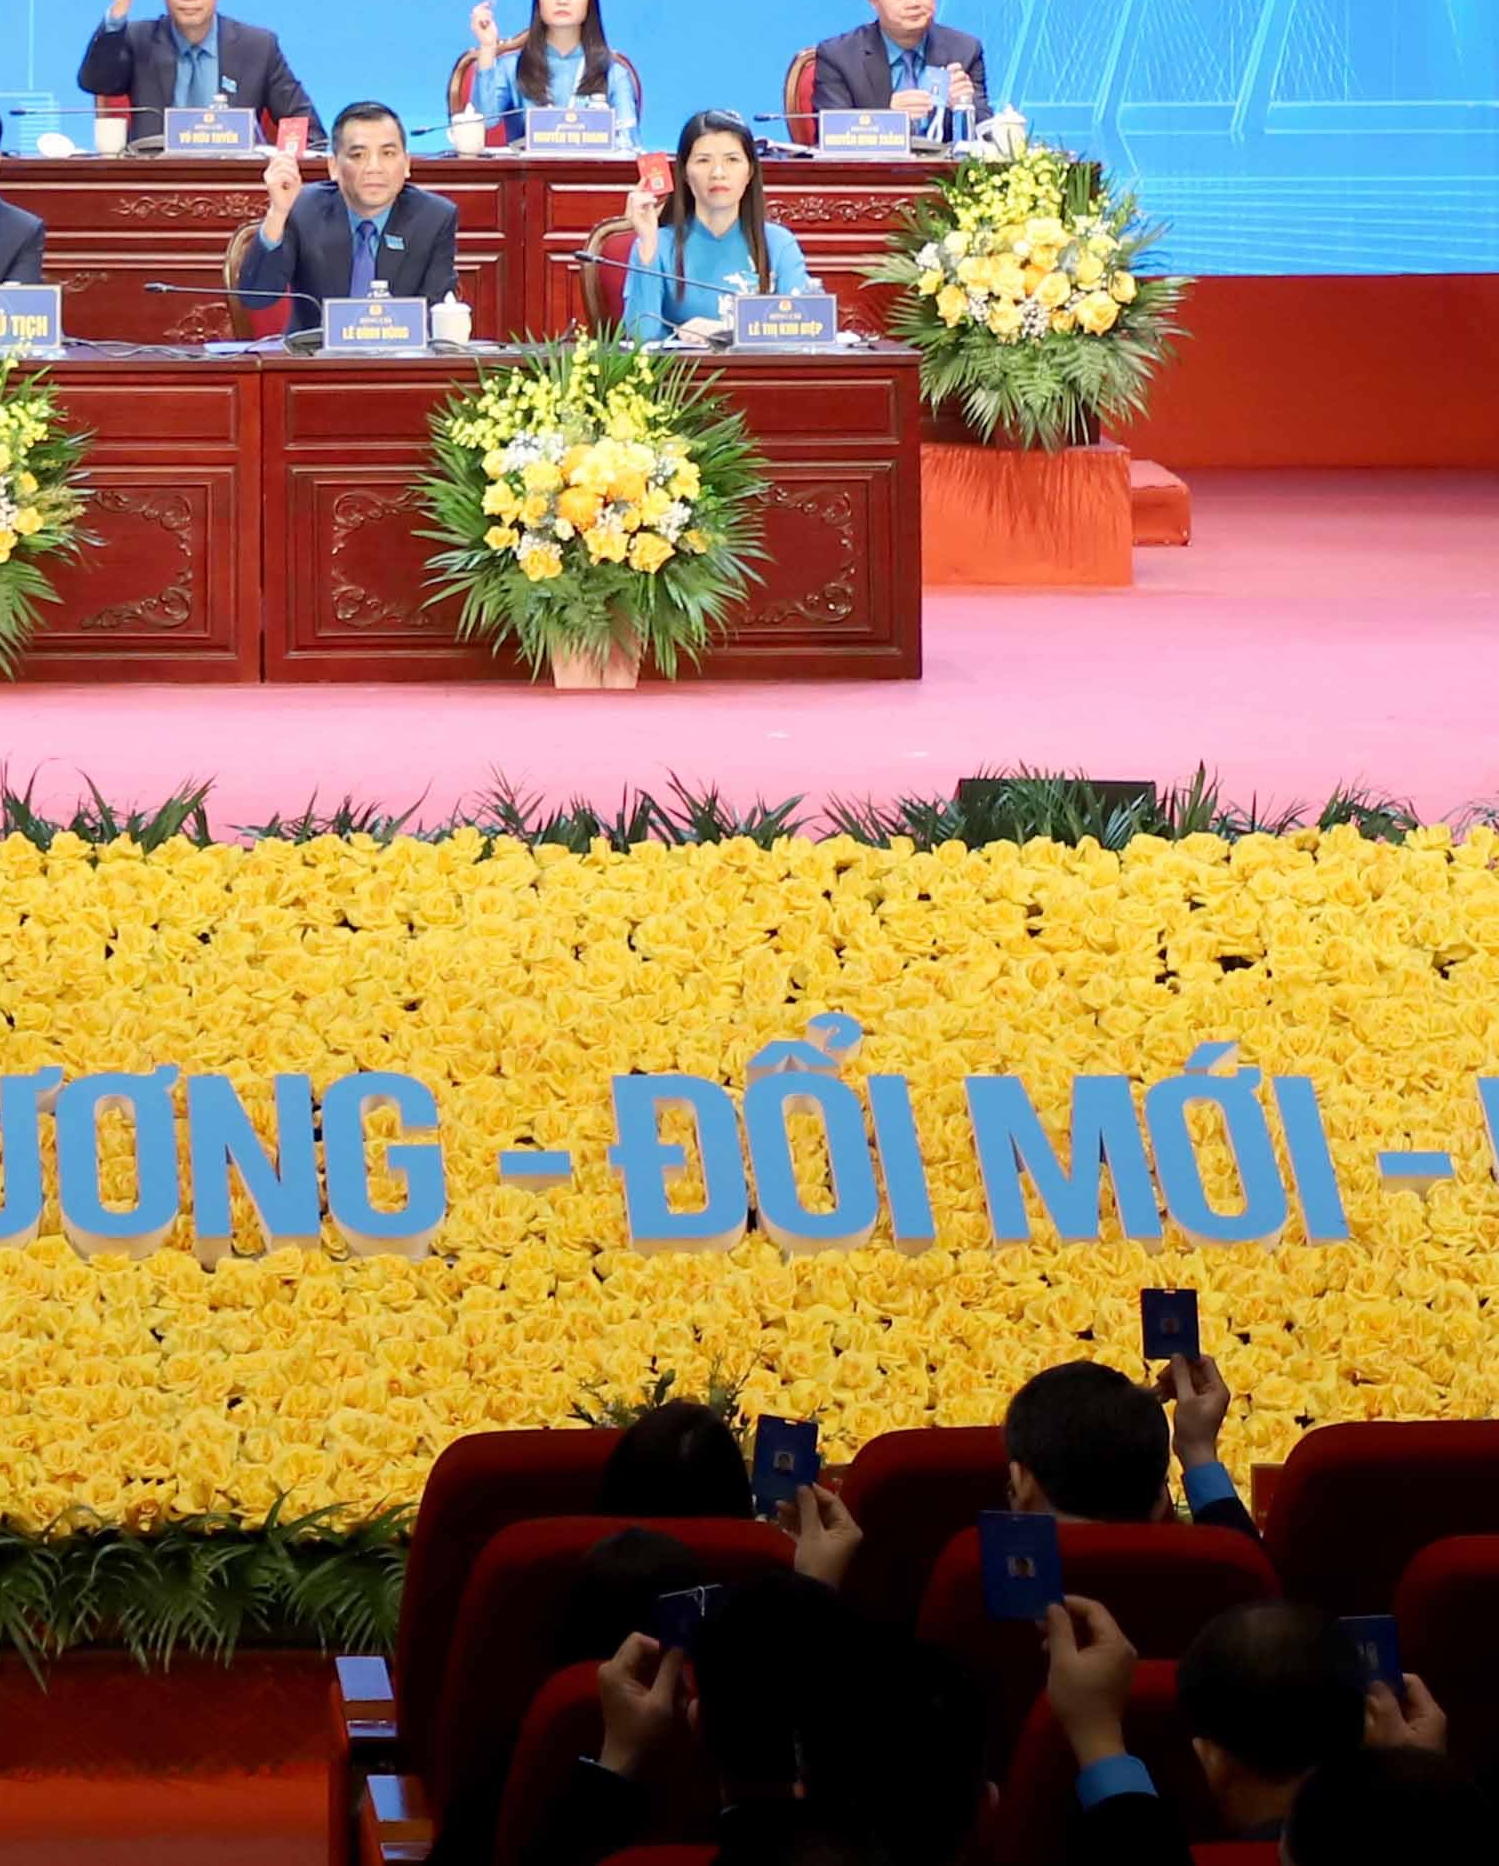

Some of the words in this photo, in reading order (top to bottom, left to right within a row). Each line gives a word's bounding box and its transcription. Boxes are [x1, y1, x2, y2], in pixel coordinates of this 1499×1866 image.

[10, 314, 49, 342] TỊCH
[607, 1011, 939, 1244] ĐỔI
[963, 1039, 1354, 1244] MỚI
